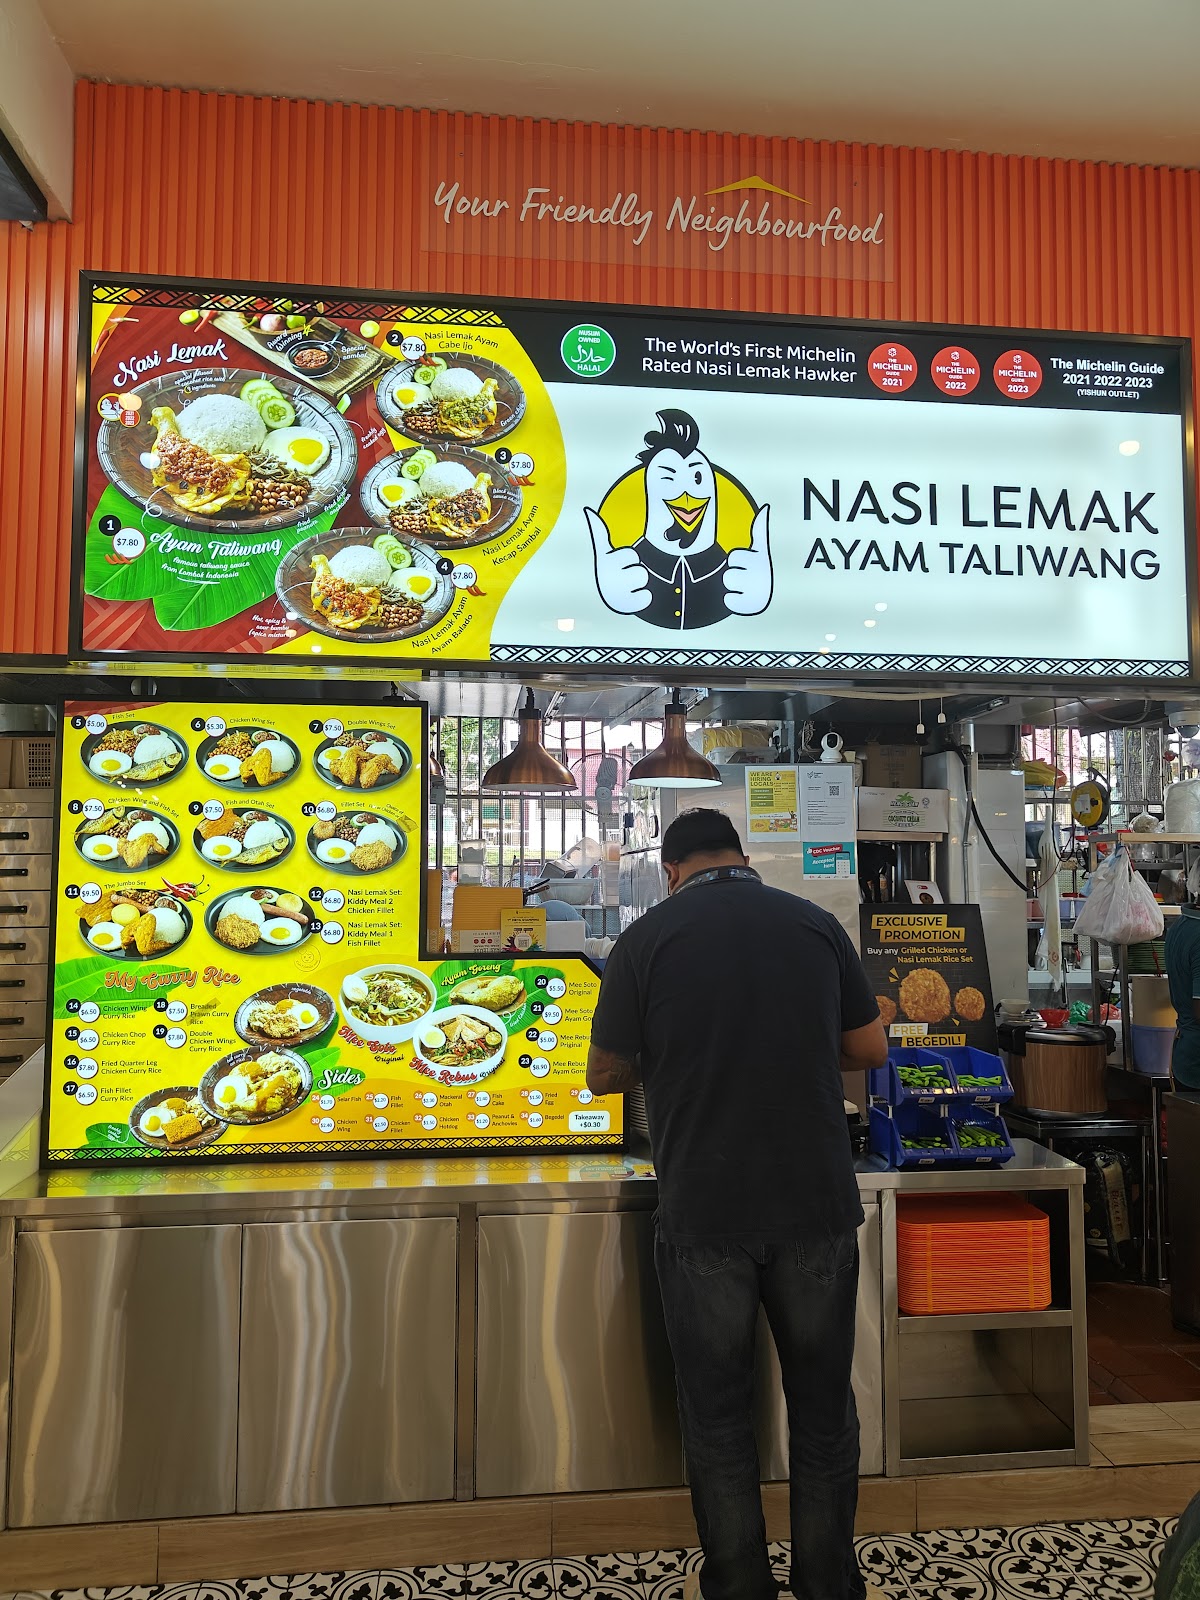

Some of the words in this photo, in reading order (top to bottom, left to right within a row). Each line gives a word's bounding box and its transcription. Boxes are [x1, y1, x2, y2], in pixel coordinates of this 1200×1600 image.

[434, 181, 509, 224] Your
[519, 188, 653, 245] Friendly
[666, 196, 883, 250] Neighbourfood
[267, 329, 287, 349] Award
[276, 331, 302, 352] Winning
[425, 331, 444, 340] Nasi
[446, 332, 473, 341] Lemak
[475, 335, 499, 348] Ayam
[341, 345, 366, 353] Special
[402, 343, 425, 352] $7.80
[645, 337, 677, 353] The
[681, 340, 741, 357] World's
[745, 343, 782, 358] First
[787, 346, 856, 362] Michelin
[113, 350, 162, 386] Nasi
[167, 338, 228, 363] Lemak
[577, 363, 601, 372] HALAL
[873, 363, 912, 371] MICHELIN
[1050, 358, 1074, 369] The
[1076, 359, 1126, 372] Michelin
[1129, 361, 1164, 374] Guide
[642, 358, 691, 373] Rated
[696, 361, 731, 376] Nasi
[736, 362, 790, 379] Lemak
[795, 366, 857, 383] Hawker
[936, 366, 975, 375] MICHELIN
[998, 370, 1038, 378] MICHELIN
[882, 378, 903, 386] 2021
[945, 381, 966, 390] 2022
[1063, 374, 1090, 385] 2021
[1093, 375, 1122, 386] 2022
[1125, 376, 1153, 388] 2023
[1008, 385, 1028, 393] 2023
[1077, 389, 1107, 397] (YISHUN
[1109, 390, 1139, 399] OUTLET)
[511, 461, 531, 469] $7.80
[804, 477, 938, 525] NASI
[961, 483, 1159, 534] LEMAK
[482, 543, 501, 557] Nasi
[505, 527, 526, 546] Lemak
[522, 505, 538, 528] Ayam
[117, 538, 138, 547] $7.80
[150, 532, 203, 554] Ayam
[208, 539, 282, 559] Taliwang
[492, 549, 516, 566] Kecap
[516, 528, 542, 552] Sambal
[173, 557, 198, 567] famous
[200, 561, 228, 571] taliwang
[804, 537, 929, 573] AYAM
[939, 542, 1161, 581] TALIWANG
[161, 564, 177, 574] from
[179, 568, 204, 578] Lombok
[453, 572, 473, 580] $7.80
[412, 634, 431, 648] Nasi
[432, 618, 455, 639] Lemak
[453, 597, 468, 619] Ayam
[431, 638, 452, 654] Ayam
[453, 614, 473, 639] Balado
[87, 720, 105, 728] $5.00
[877, 917, 942, 926] EXCLUSIVE
[885, 931, 960, 939] PROMOTION
[867, 948, 882, 956] Buy
[105, 971, 137, 991] My
[141, 970, 198, 989] Curry
[203, 966, 240, 987] Rice
[441, 969, 467, 986] Ayam
[468, 964, 501, 976] Goreng
[894, 1026, 923, 1035] FREE
[907, 1036, 961, 1046] BEGEDIL!
[375, 1055, 404, 1064] Original
[409, 1057, 436, 1077] Mee
[438, 1071, 477, 1085] Rebus
[480, 1057, 505, 1077] Original
[318, 1068, 362, 1089] Sides
